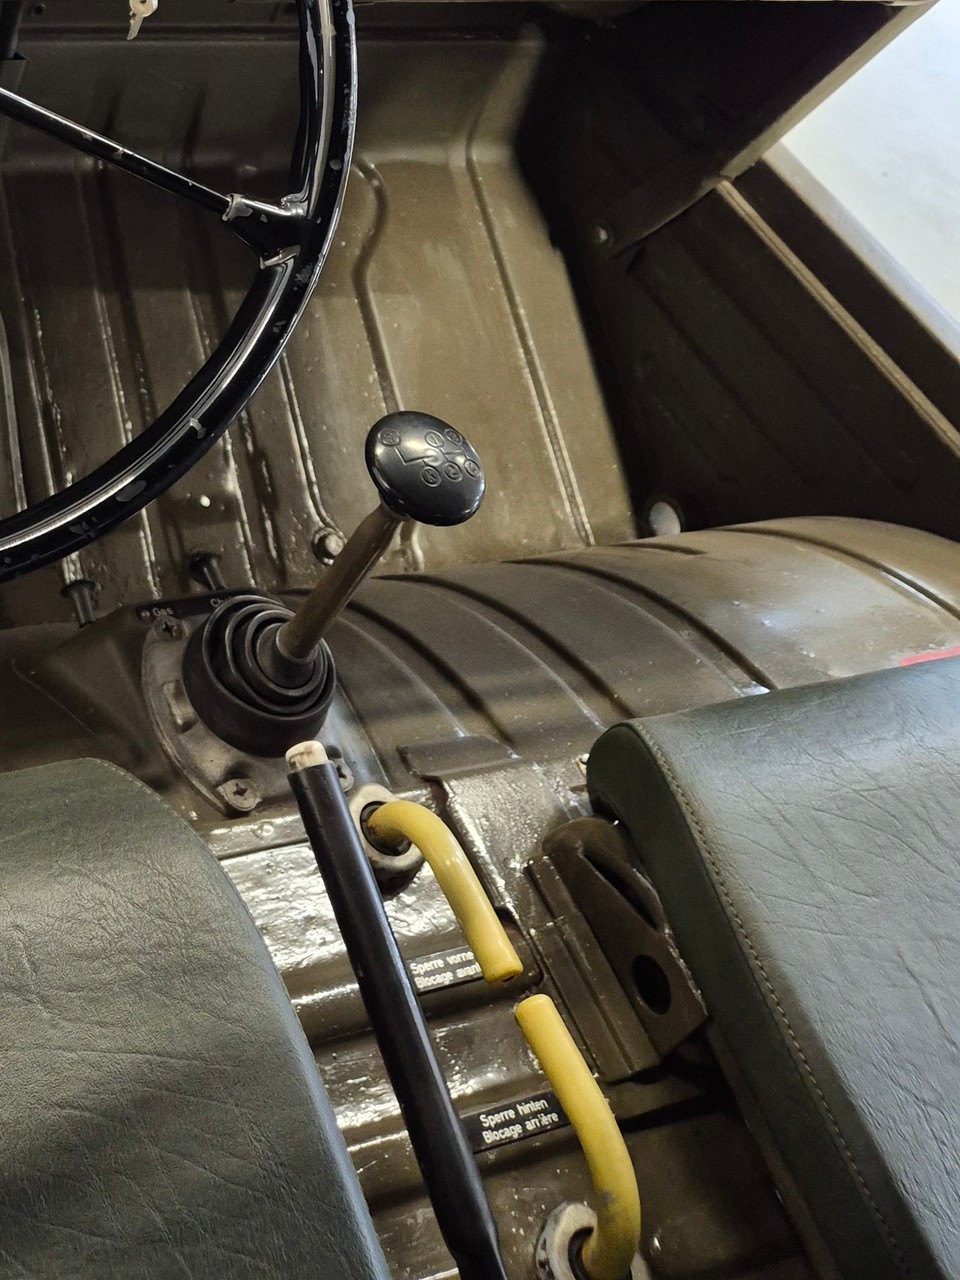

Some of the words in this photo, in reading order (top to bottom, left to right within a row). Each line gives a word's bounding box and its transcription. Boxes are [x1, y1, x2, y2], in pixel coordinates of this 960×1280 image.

[152, 607, 174, 616] Gas
[410, 959, 445, 975] Sperre
[446, 951, 474, 965] vorne
[414, 971, 454, 989] Blocage
[479, 1108, 516, 1128] Sperre
[516, 1099, 549, 1116] hinten
[482, 1123, 523, 1144] Blocage
